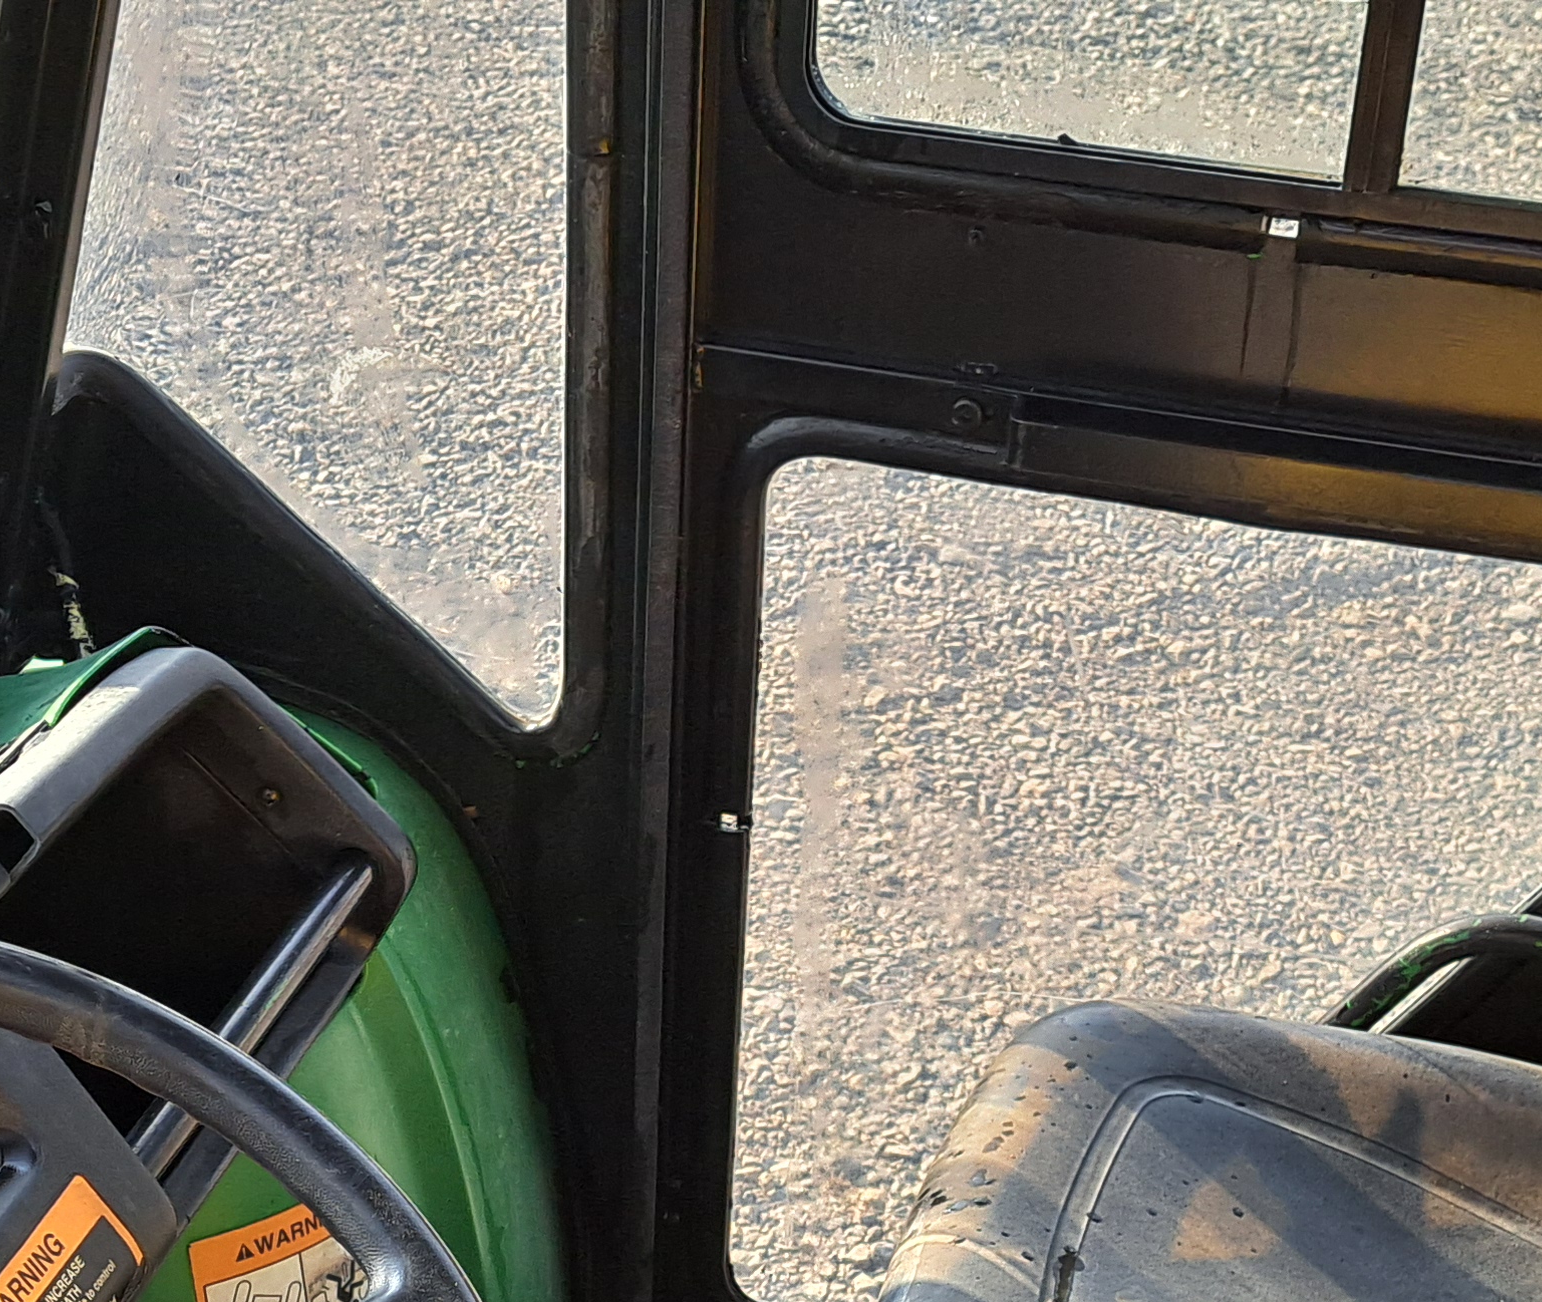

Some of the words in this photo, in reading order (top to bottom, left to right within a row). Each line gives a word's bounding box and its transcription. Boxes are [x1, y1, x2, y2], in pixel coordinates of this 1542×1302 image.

[254, 1216, 324, 1254] WARN
[85, 1289, 95, 1300] to
[93, 1259, 115, 1291] control
